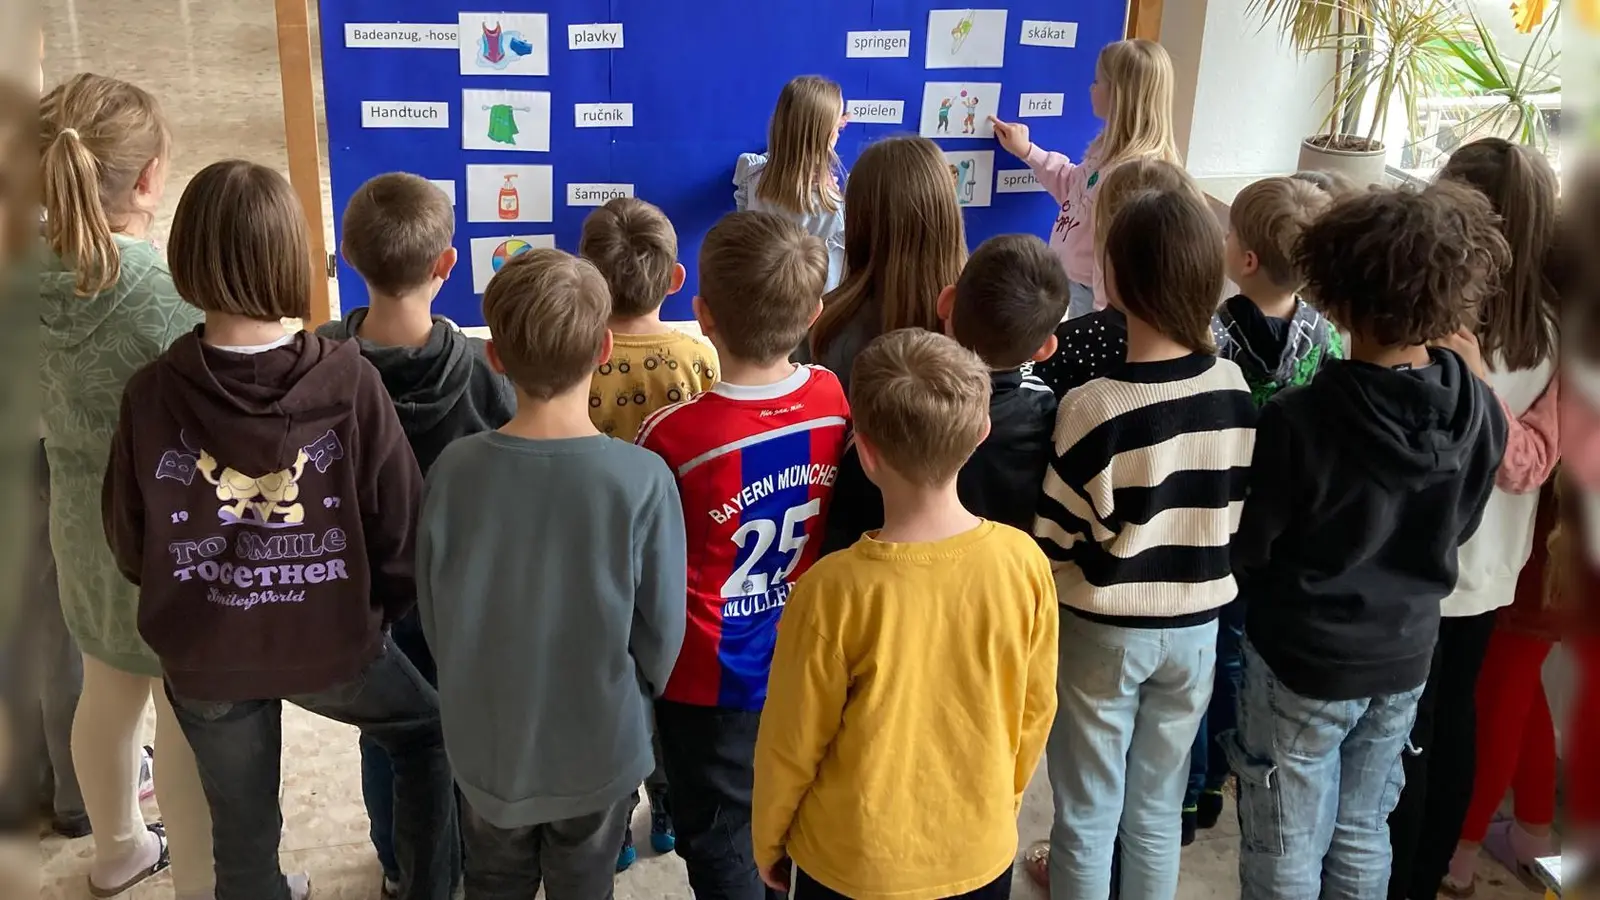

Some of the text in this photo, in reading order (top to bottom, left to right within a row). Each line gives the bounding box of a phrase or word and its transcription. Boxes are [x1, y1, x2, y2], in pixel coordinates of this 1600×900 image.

[353, 29, 457, 42] Badeanzug, -hose
[574, 30, 617, 44] plavky
[1028, 26, 1066, 40] skákat
[854, 36, 907, 51] springen
[853, 104, 896, 117] spielen
[1028, 98, 1052, 110] hrát
[370, 106, 438, 119] Handtuch
[583, 109, 624, 122] ručník
[575, 188, 626, 202] šampón
[709, 463, 839, 524] BAYERN MÜNCHE
[170, 510, 189, 524] 19
[169, 536, 227, 565] TO
[720, 498, 821, 598] 25
